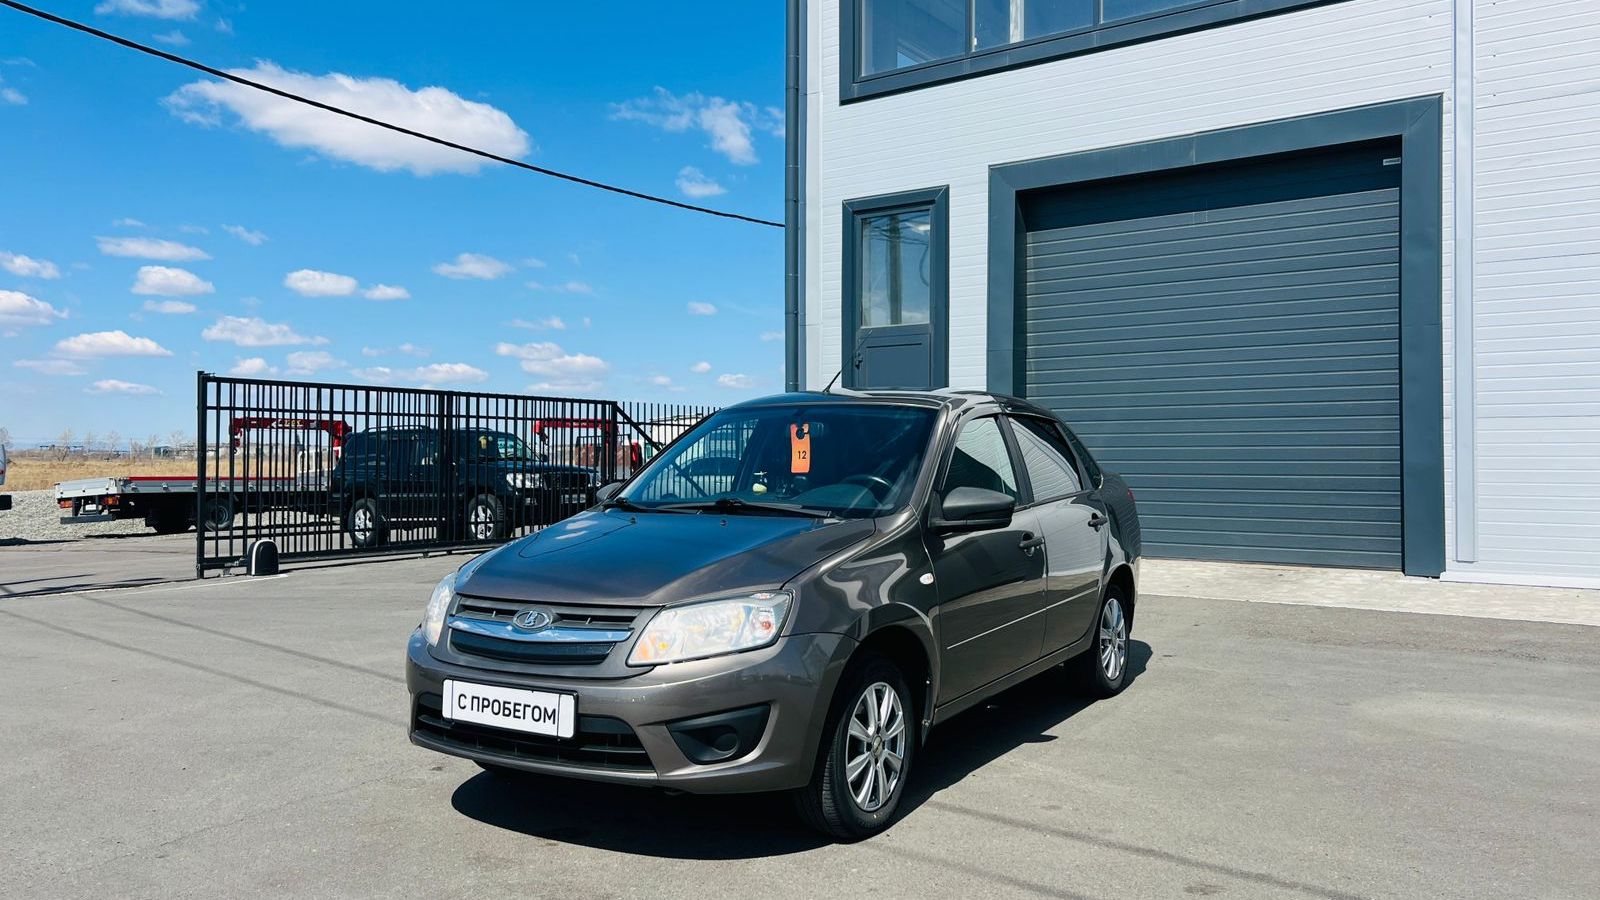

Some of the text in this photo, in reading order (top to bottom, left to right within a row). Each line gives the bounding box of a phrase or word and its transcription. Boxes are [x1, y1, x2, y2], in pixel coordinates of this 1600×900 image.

[797, 450, 807, 460] 12
[457, 693, 557, 725] С ПРОБЕГОМ
